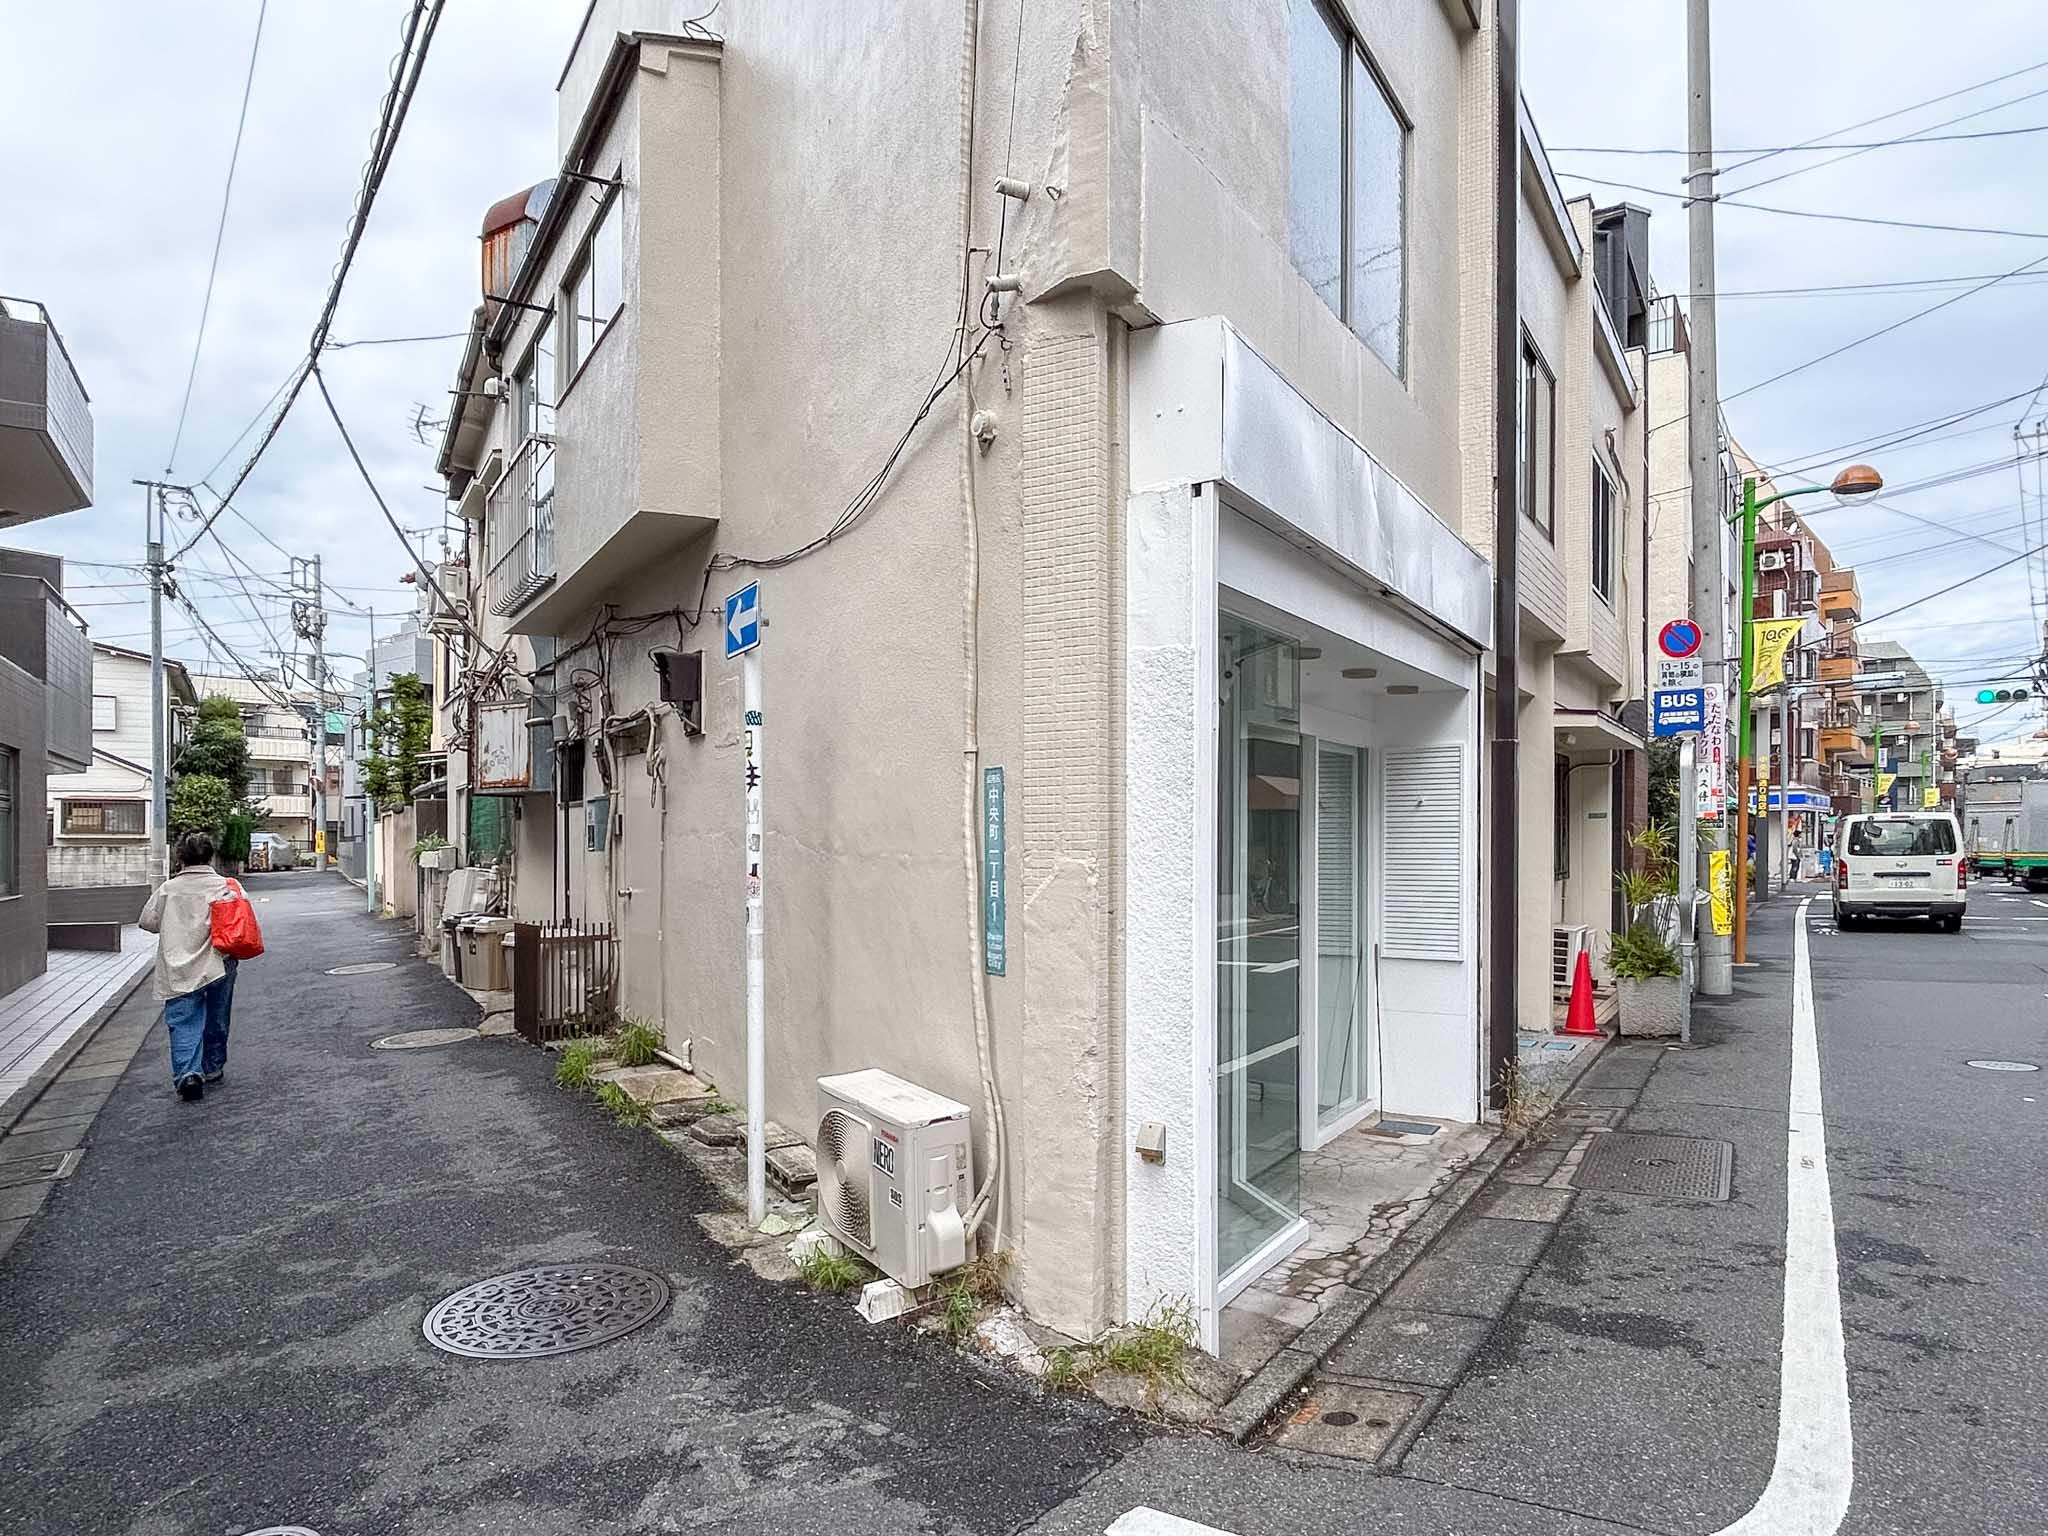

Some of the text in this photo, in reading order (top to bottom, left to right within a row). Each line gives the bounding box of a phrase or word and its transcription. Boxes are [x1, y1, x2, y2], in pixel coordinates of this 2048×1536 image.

[1660, 693, 1698, 708] BUS
[1698, 764, 1709, 803] バス停
